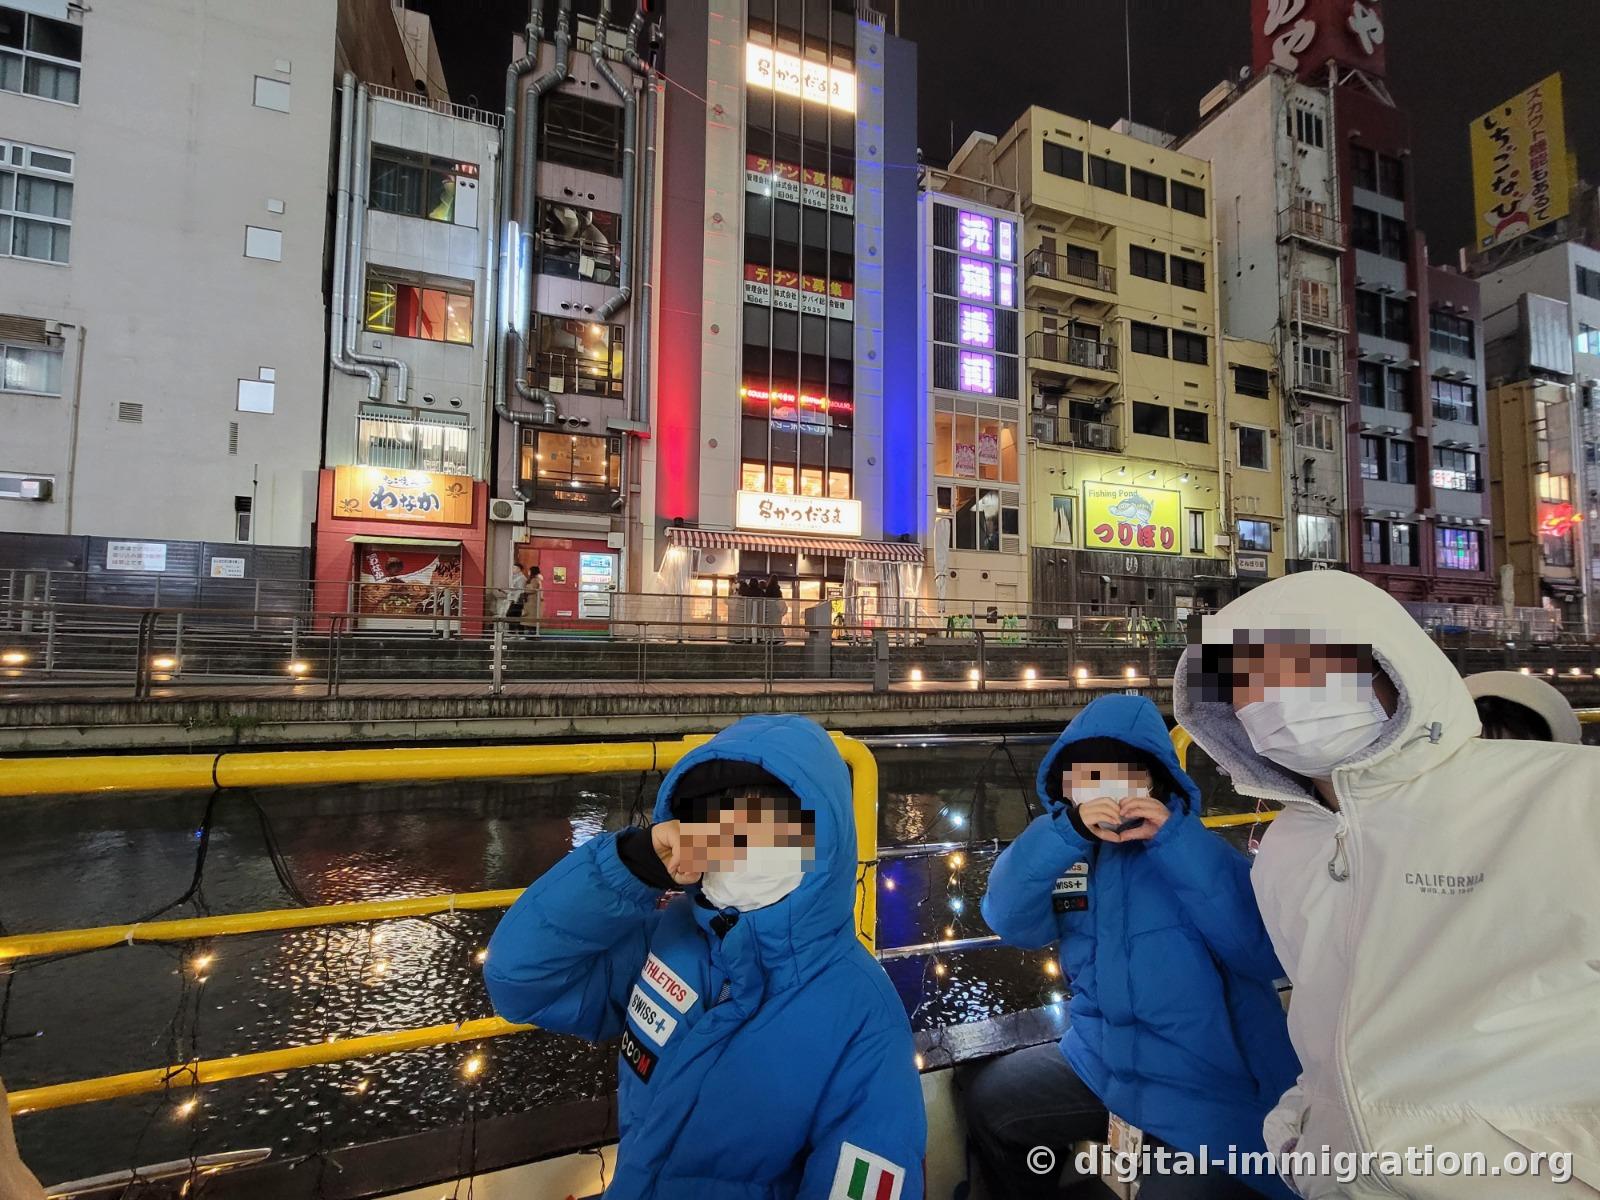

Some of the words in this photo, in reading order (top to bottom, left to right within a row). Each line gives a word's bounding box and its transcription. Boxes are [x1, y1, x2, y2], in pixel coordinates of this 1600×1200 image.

[756, 158, 843, 191] テナント募集
[755, 267, 842, 297] テナント募集
[369, 485, 440, 512] わなか
[1088, 489, 1117, 499] Fishing
[1119, 489, 1138, 497] Pond
[758, 498, 842, 524] 串かつだるま
[1405, 872, 1484, 888] CALIFORNIA
